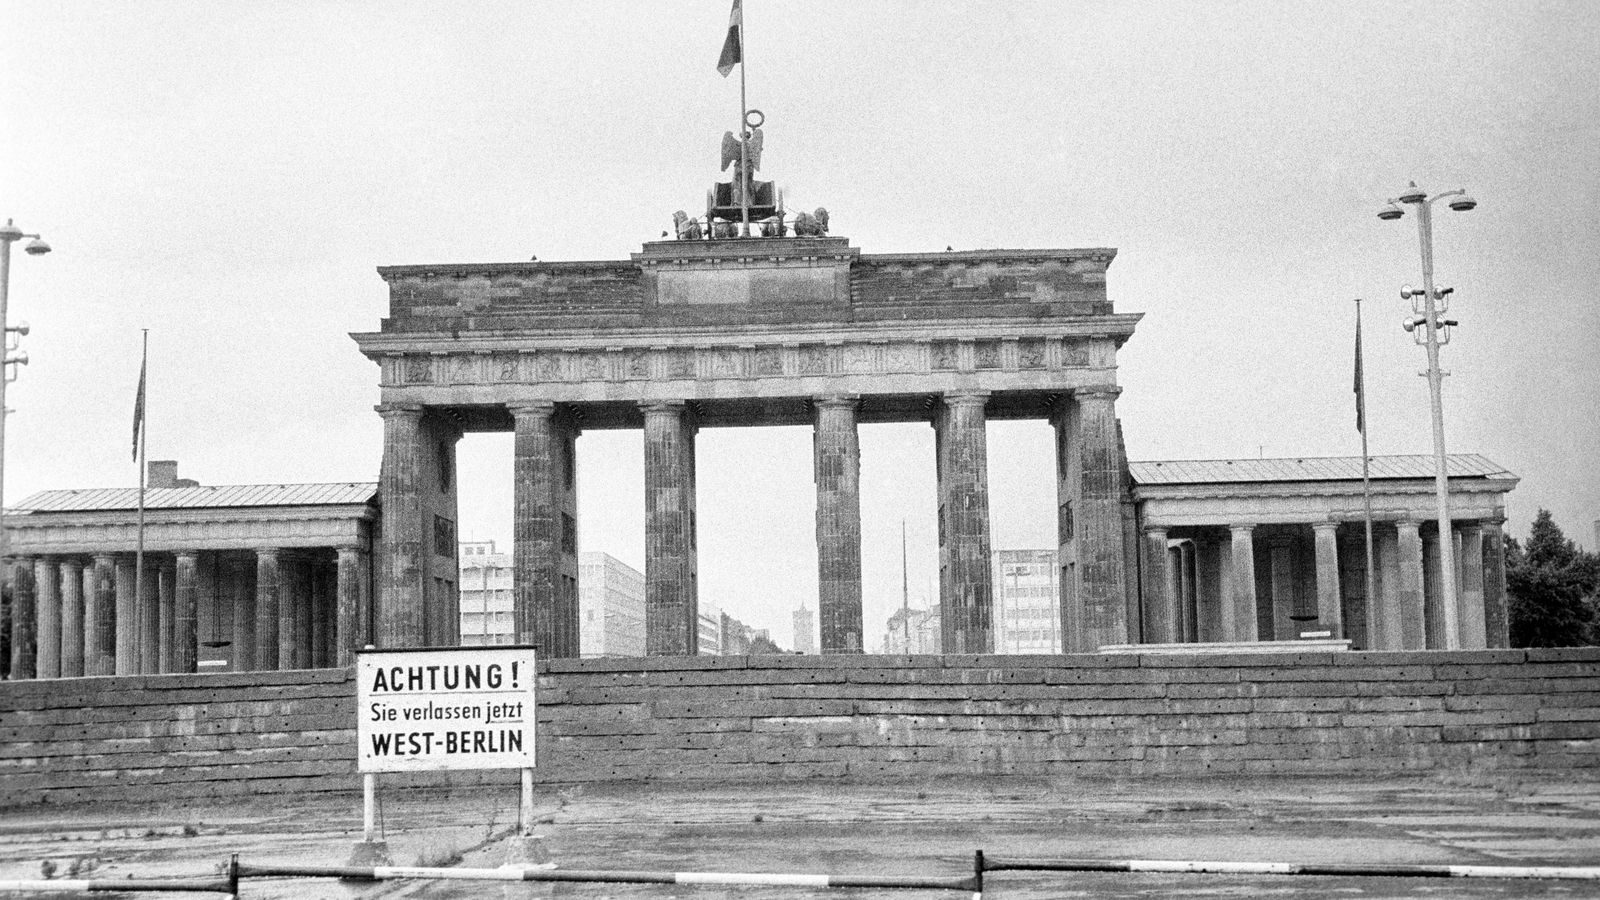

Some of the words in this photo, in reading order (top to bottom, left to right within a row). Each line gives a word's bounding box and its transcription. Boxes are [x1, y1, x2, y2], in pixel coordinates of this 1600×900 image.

[371, 702, 397, 721] Sie
[403, 700, 481, 720] verlassen
[485, 701, 523, 724] jetzt
[371, 730, 523, 756] WEST-BERLIN
